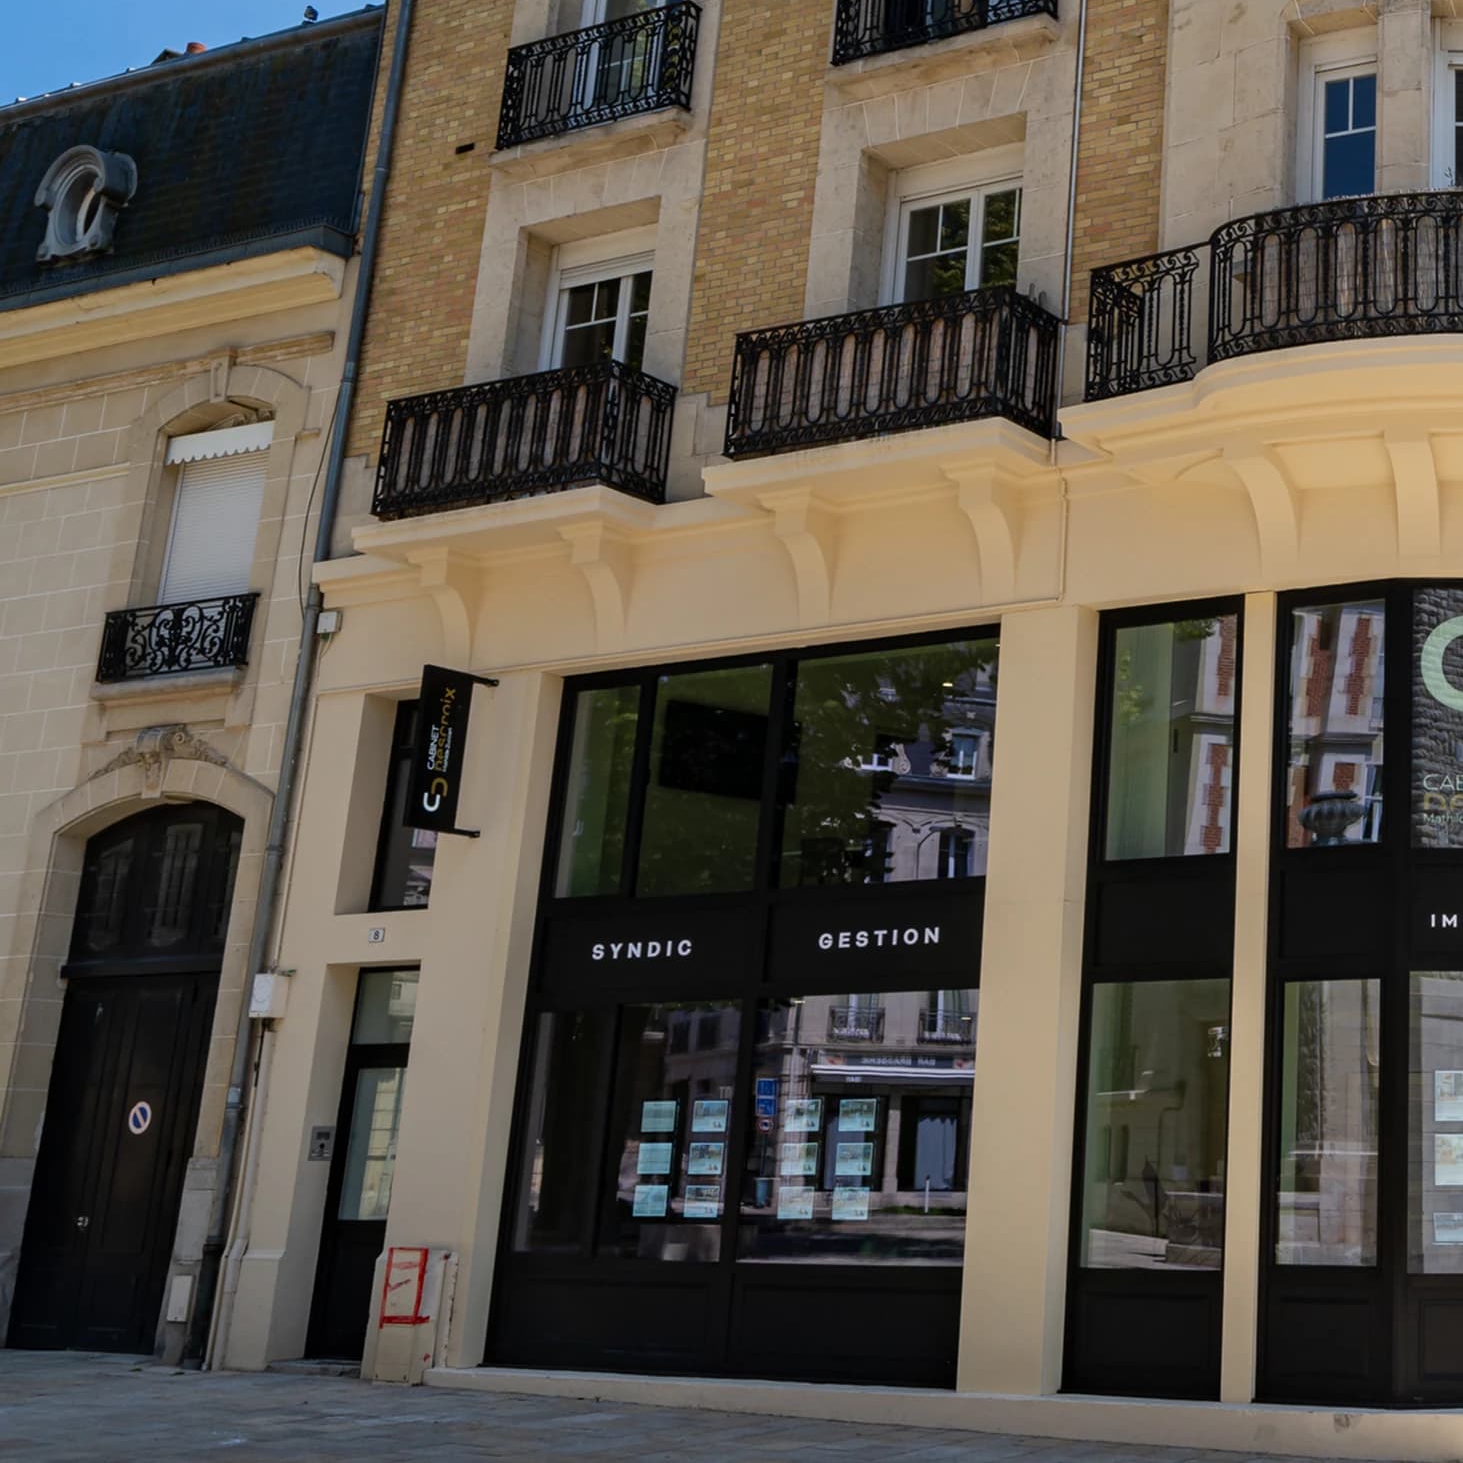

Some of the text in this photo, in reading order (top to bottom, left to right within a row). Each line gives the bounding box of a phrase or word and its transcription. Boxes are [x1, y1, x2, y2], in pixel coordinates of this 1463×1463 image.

[427, 724, 440, 771] CABINET
[373, 929, 380, 941] 8
[818, 926, 940, 950] GESTION
[591, 939, 693, 960] SYNDIC
